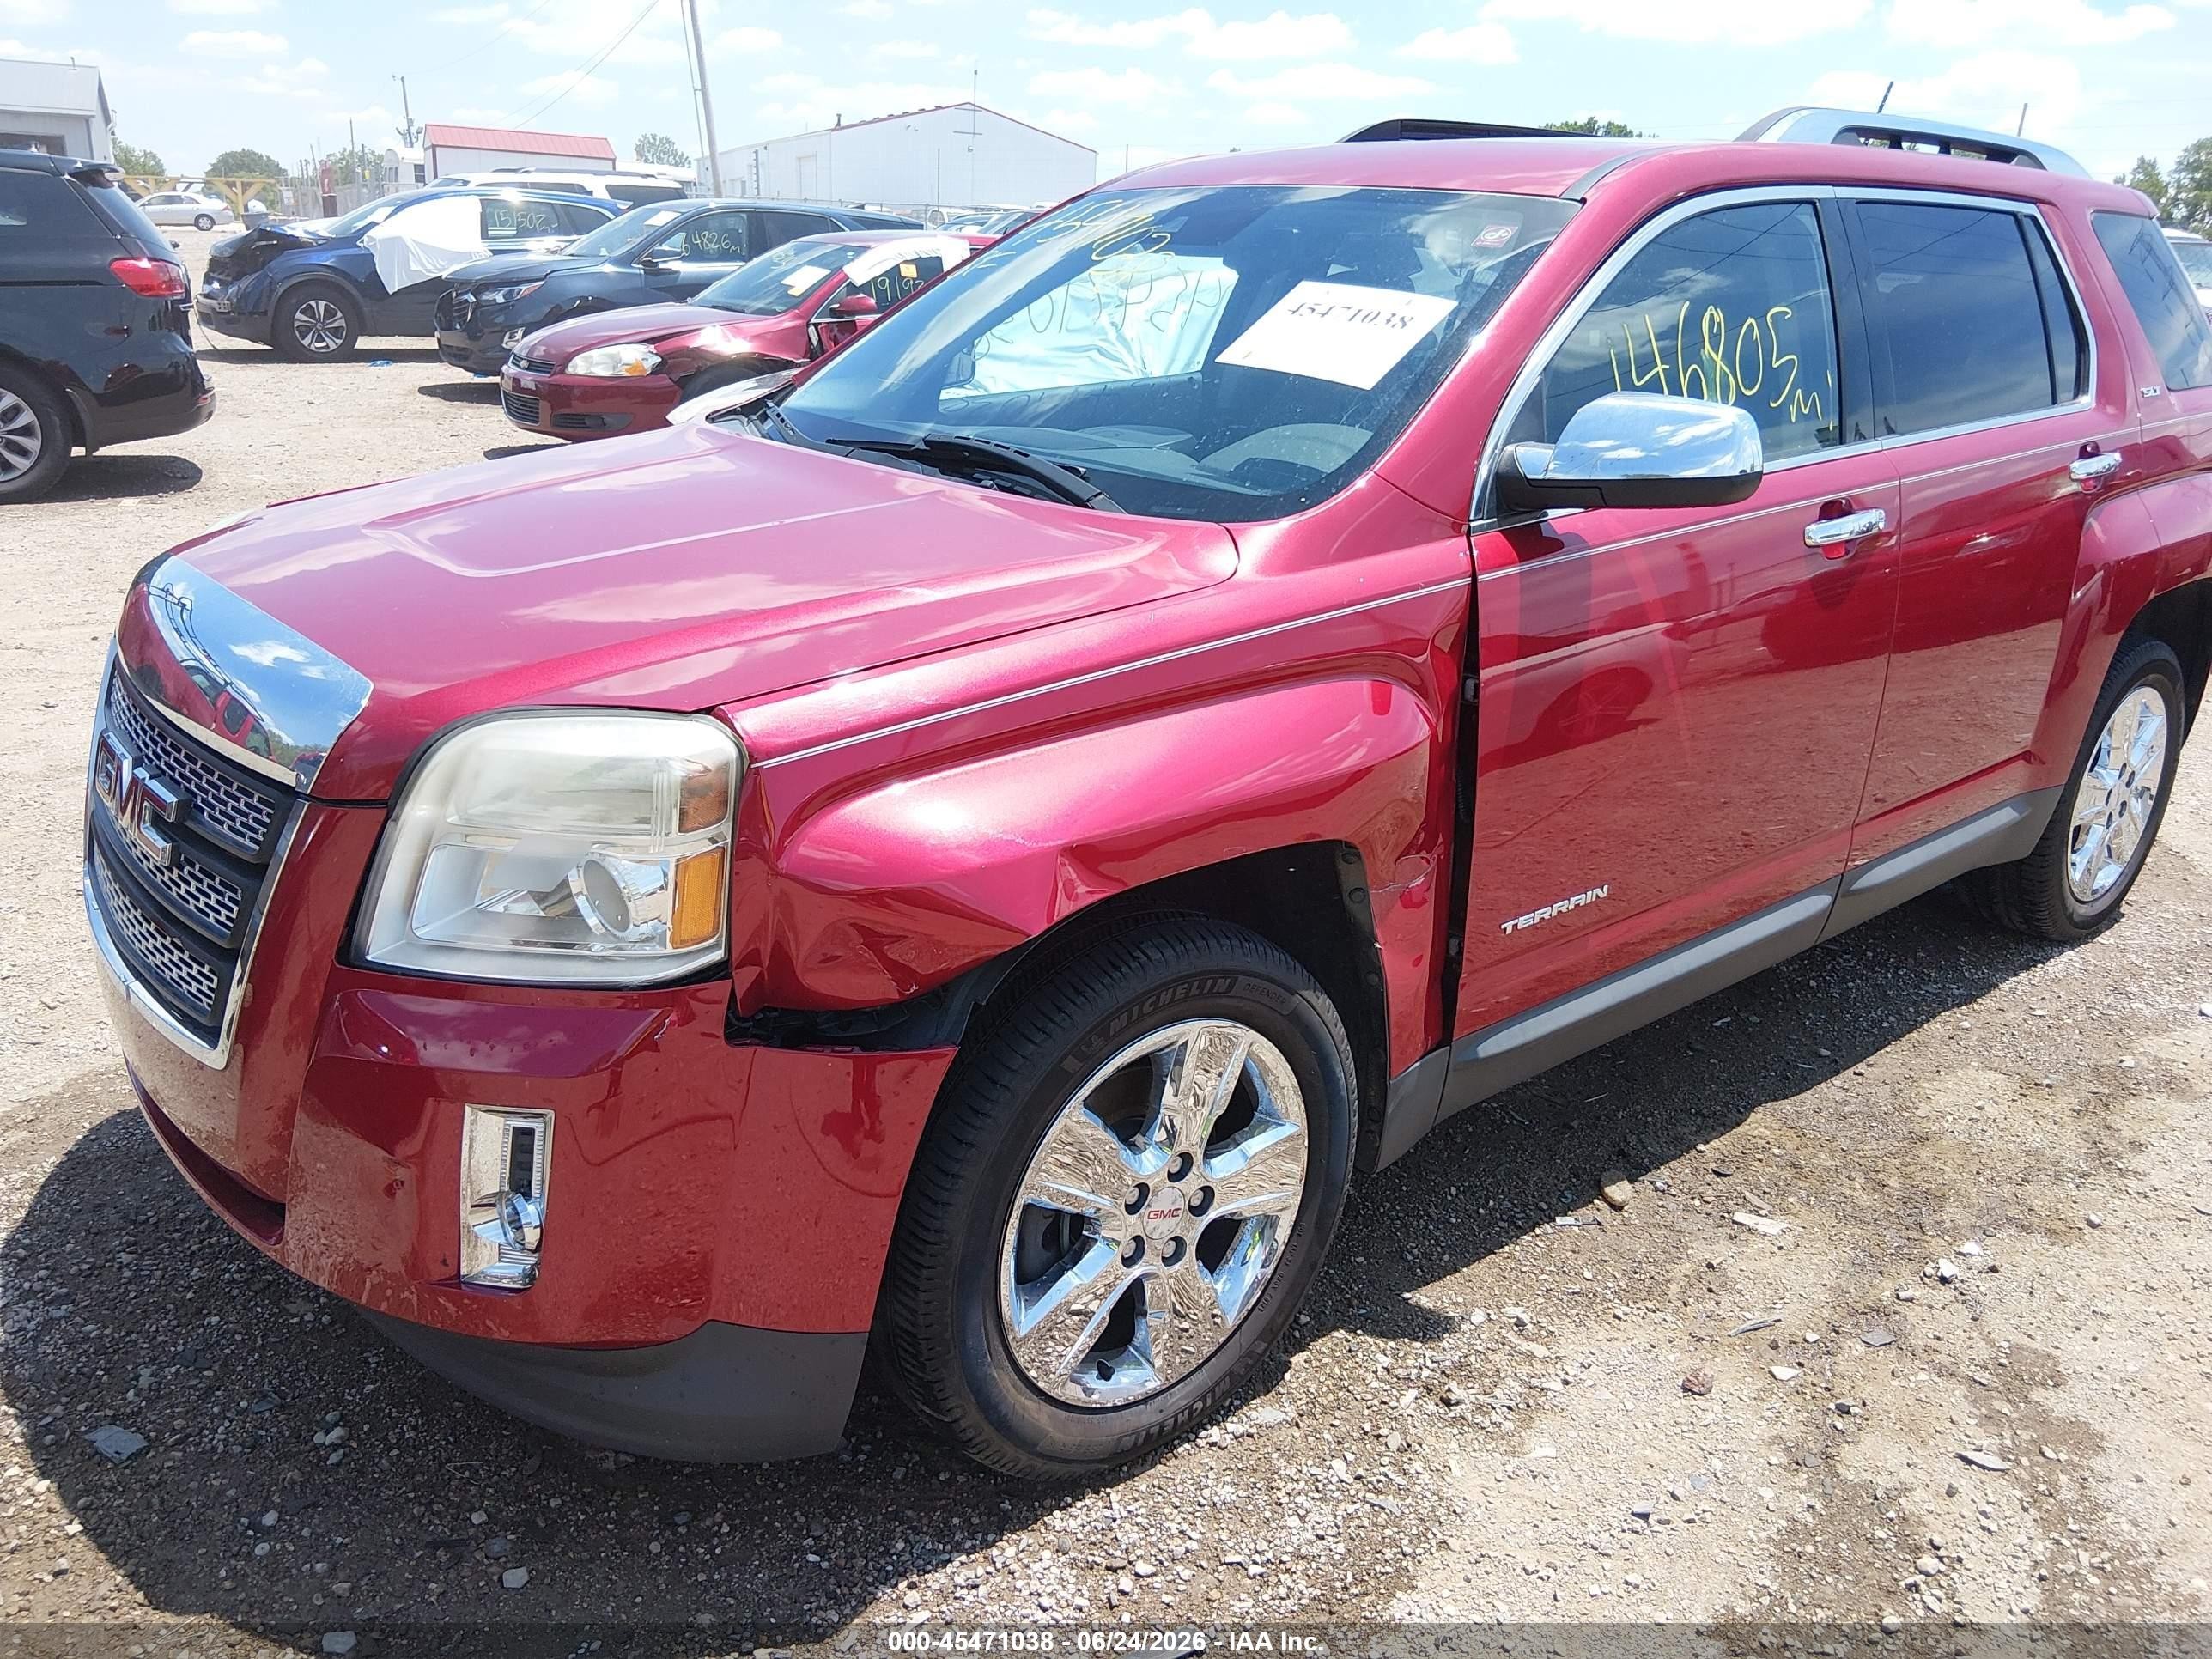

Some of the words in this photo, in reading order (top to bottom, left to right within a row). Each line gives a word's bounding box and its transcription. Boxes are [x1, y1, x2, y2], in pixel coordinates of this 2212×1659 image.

[1607, 301, 1799, 408] 146805
[96, 732, 179, 866] GMC
[1500, 884, 1609, 934] TERRAIN
[1109, 977, 1233, 1036] MICHELIN
[1147, 1207, 1182, 1220] GMC
